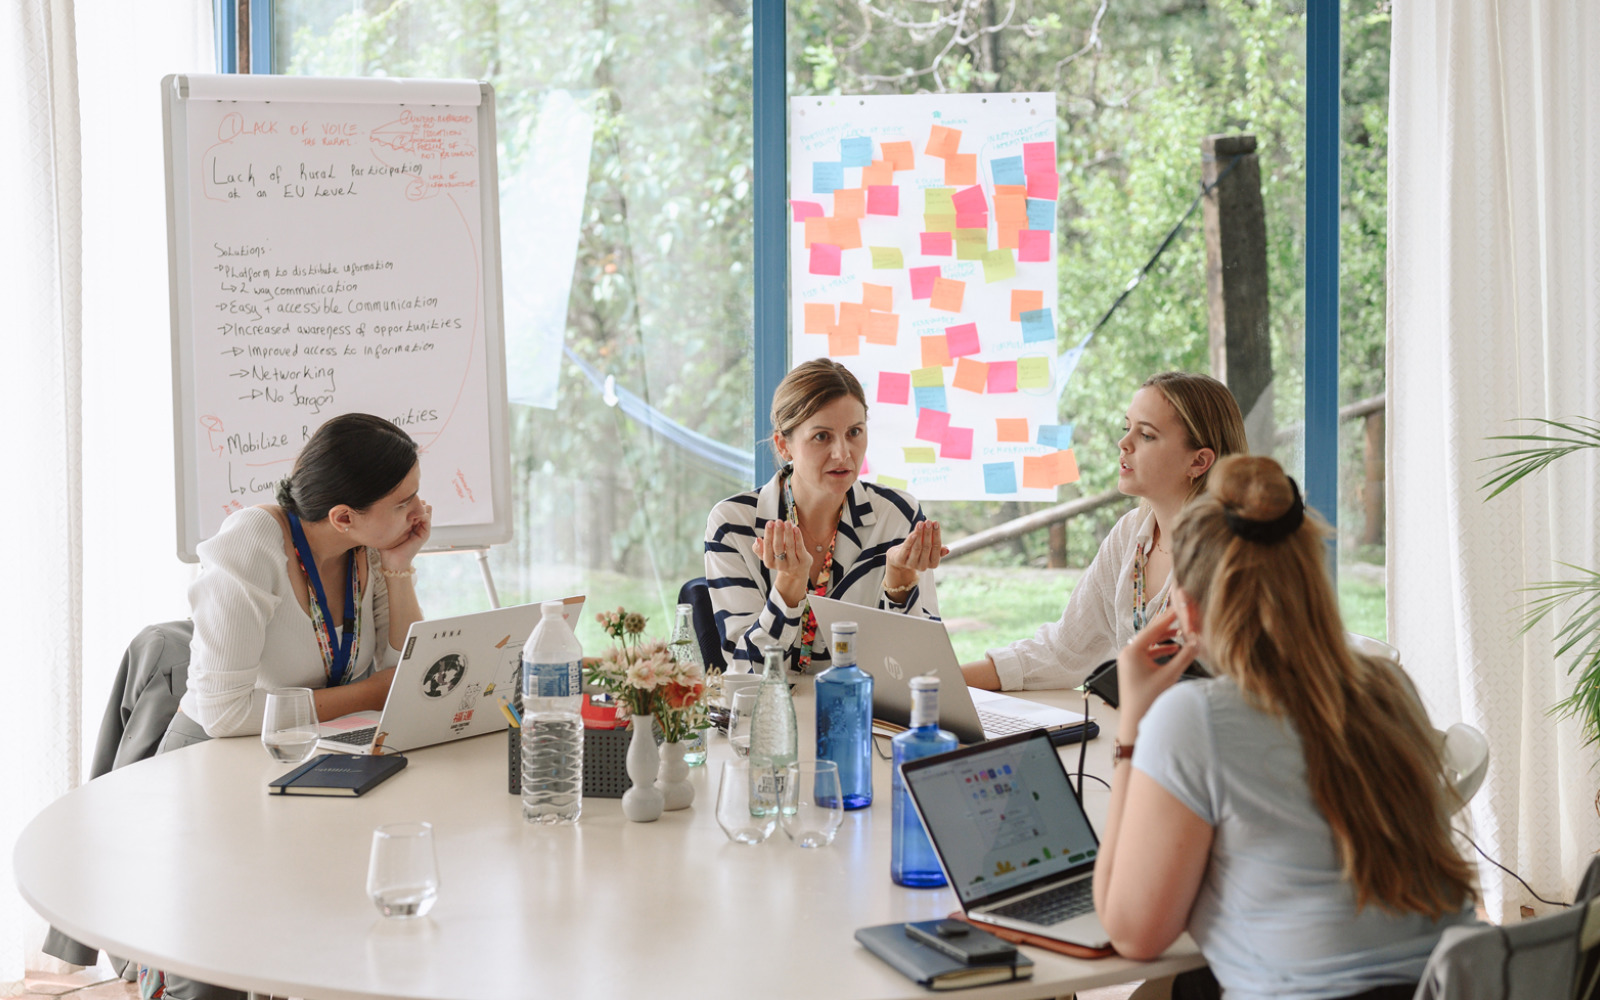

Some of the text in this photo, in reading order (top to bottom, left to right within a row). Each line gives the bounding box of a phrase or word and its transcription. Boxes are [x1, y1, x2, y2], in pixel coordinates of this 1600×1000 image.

[241, 120, 278, 135] LACK
[290, 121, 310, 135] OF
[269, 165, 282, 184] of
[351, 162, 423, 178] Participation
[228, 182, 358, 198] at an EU Level
[275, 267, 288, 277] to
[240, 280, 358, 302] 2 way communication
[229, 300, 262, 321] Easy
[276, 297, 343, 314] accessible
[234, 318, 462, 340] Increased awareness of opportunities
[248, 343, 298, 358] Improved
[303, 345, 338, 357] access
[343, 343, 357, 356] to
[252, 365, 336, 393] Networking
[265, 386, 284, 403] No
[227, 431, 289, 455] Mobilize
